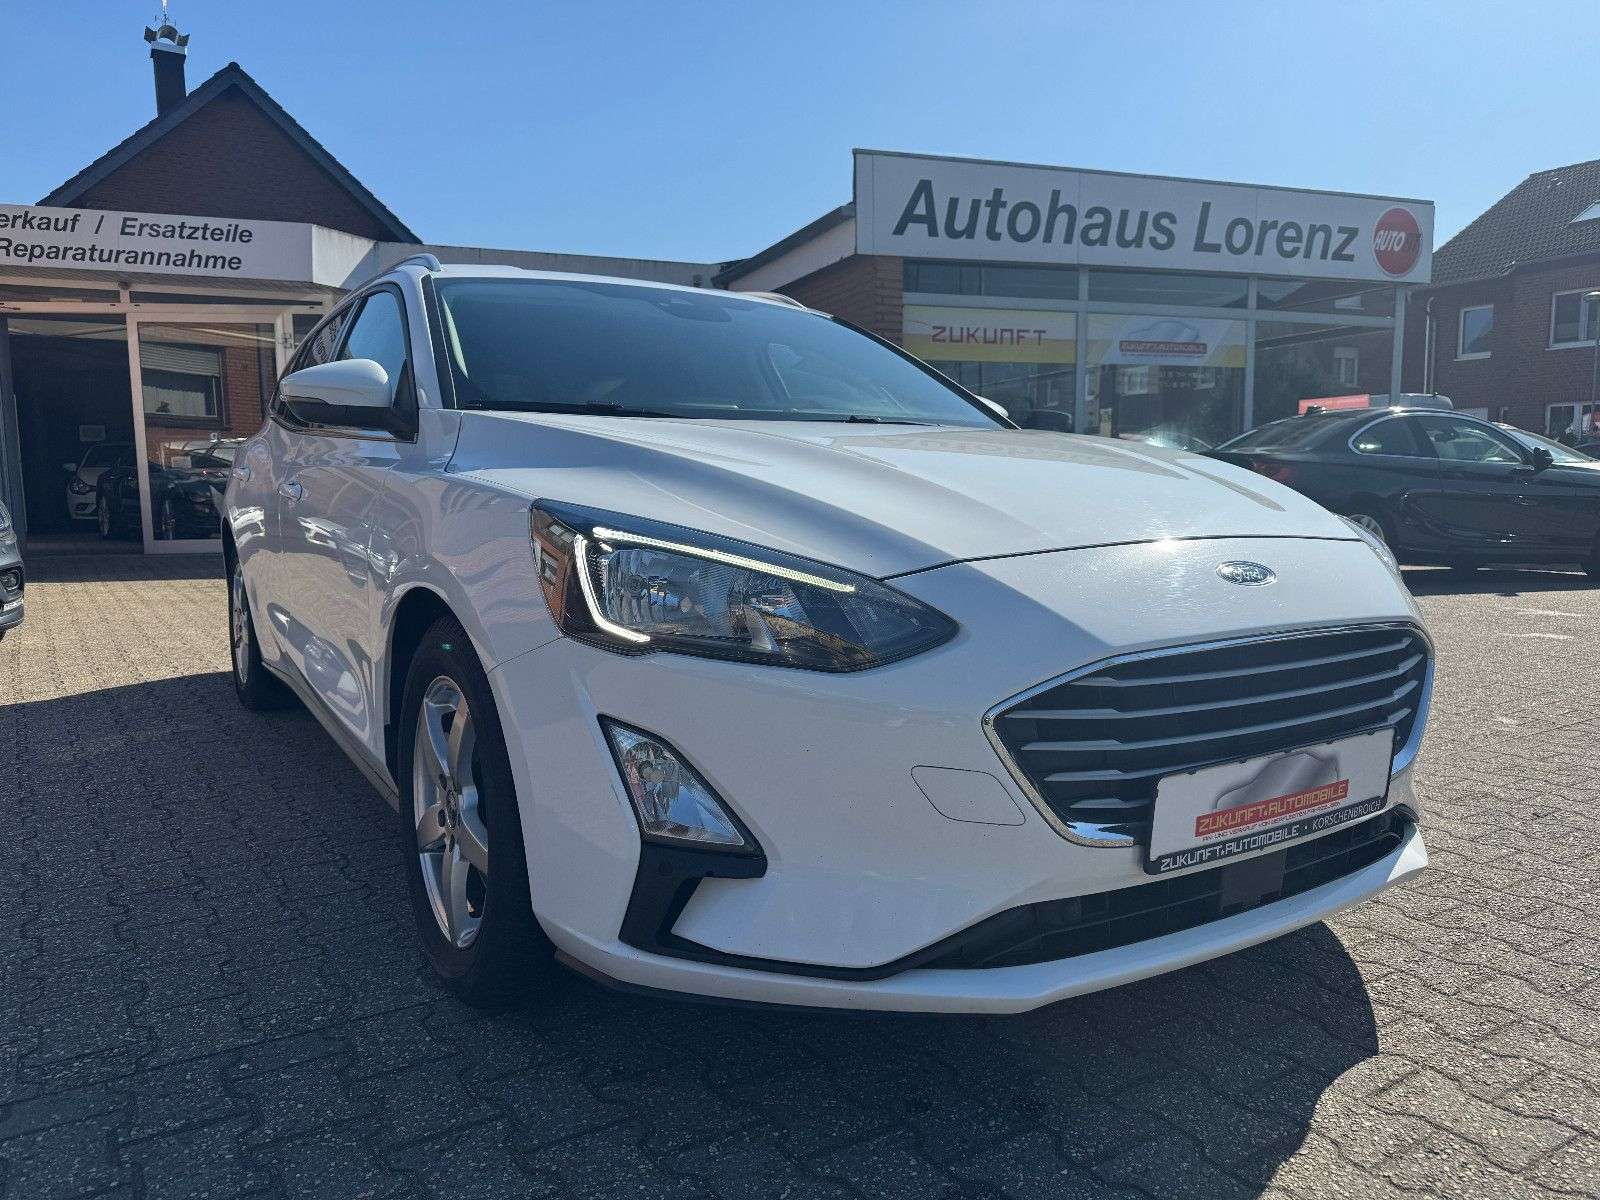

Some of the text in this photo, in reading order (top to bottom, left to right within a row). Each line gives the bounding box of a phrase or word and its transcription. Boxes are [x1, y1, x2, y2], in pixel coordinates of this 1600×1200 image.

[119, 217, 254, 244] Ersatzteile
[892, 178, 1361, 262] Autohaus Lorenz
[0, 237, 242, 271] Reparaturannahme
[931, 325, 1047, 346] ZUKUNFT
[1311, 799, 1382, 831] KORSCHENBROICH
